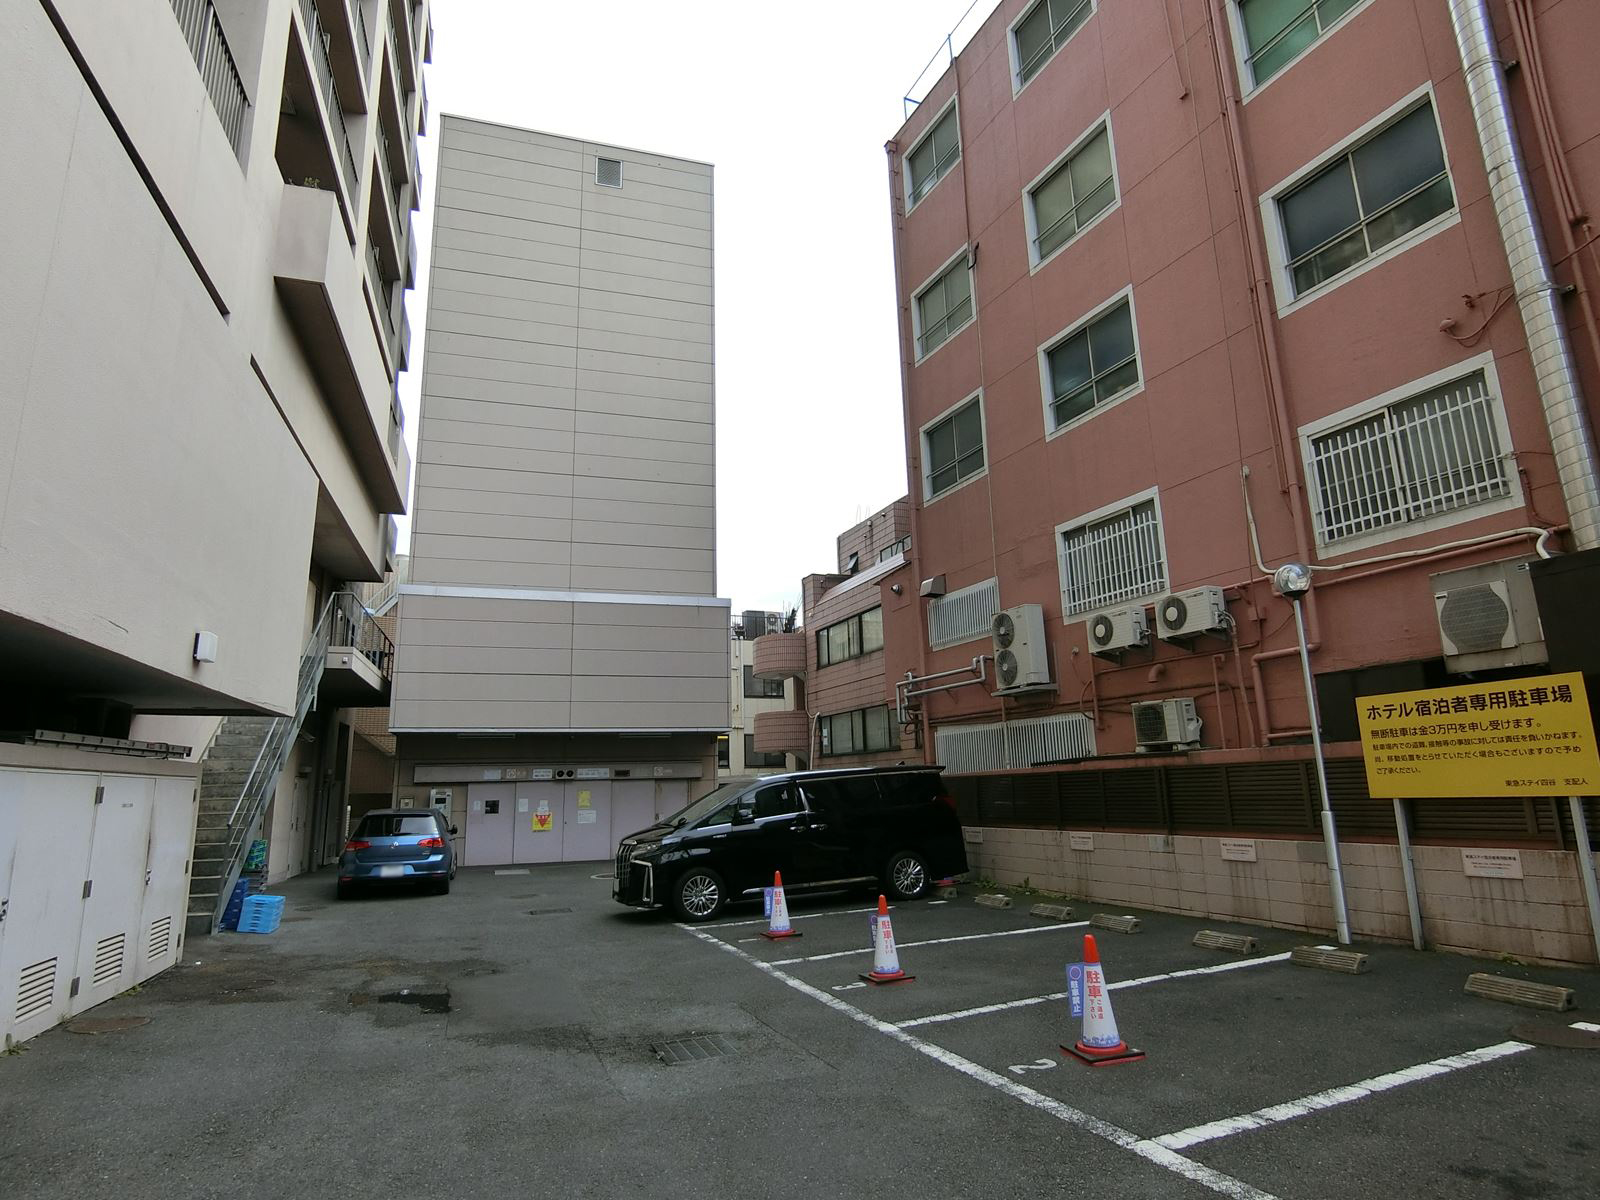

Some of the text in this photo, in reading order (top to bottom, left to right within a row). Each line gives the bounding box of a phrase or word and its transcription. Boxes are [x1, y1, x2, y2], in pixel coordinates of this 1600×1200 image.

[1366, 684, 1573, 721] ホテル宿泊者専用駐車場
[1370, 718, 1542, 739] 無断駐車は金3万円を申し受けます。
[1086, 970, 1102, 998] 駐車
[1007, 1058, 1058, 1075] 2
